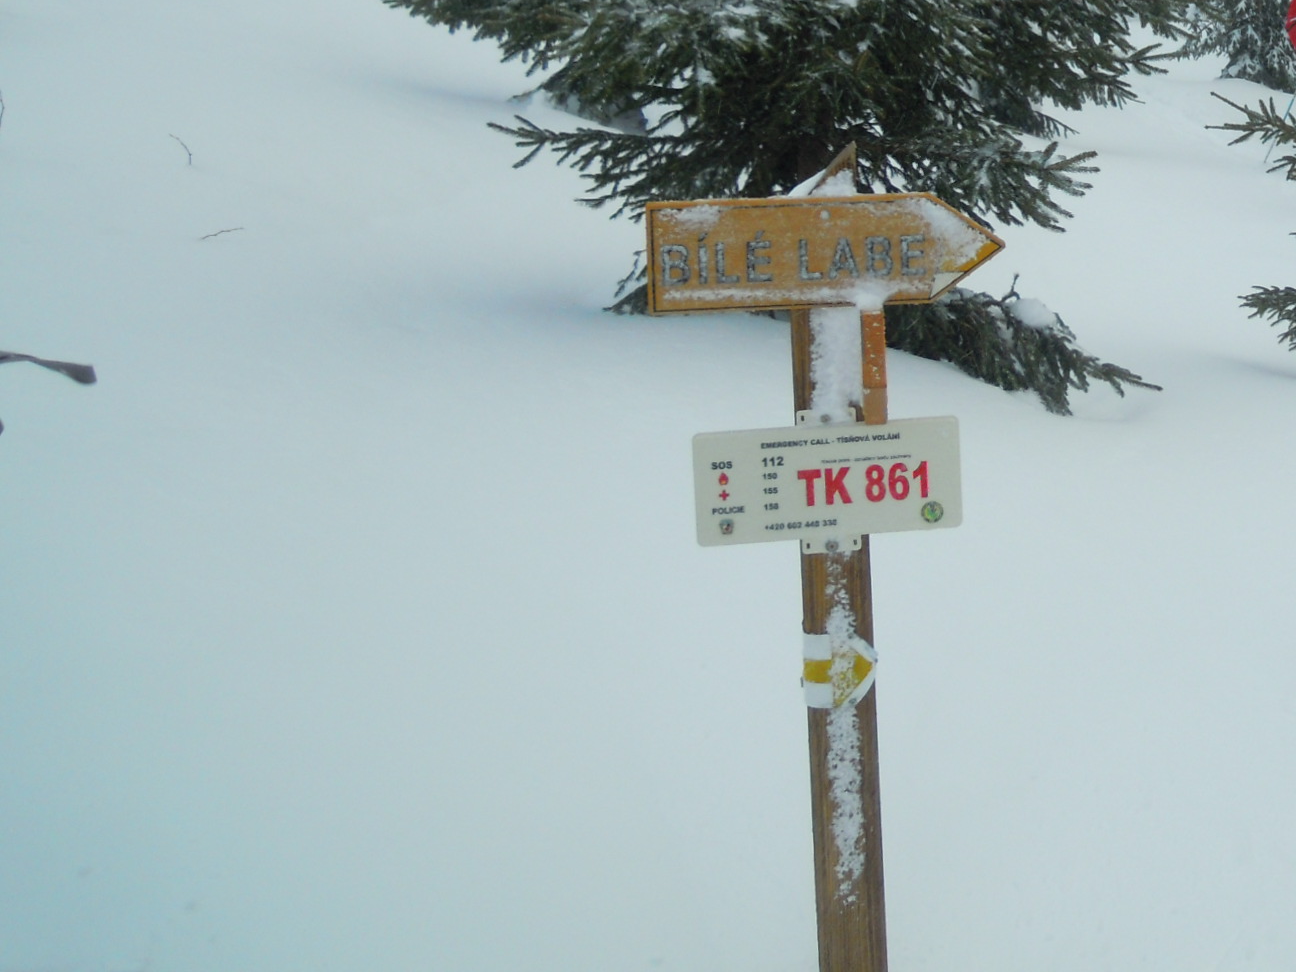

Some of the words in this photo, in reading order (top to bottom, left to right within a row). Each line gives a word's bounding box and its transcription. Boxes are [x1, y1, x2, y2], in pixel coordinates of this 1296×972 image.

[661, 230, 773, 286] BÍLÉ
[798, 234, 926, 281] LABE
[760, 440, 808, 449] EMERGENCY
[810, 438, 830, 446] CALL
[871, 432, 901, 442] VOLÁNÍ
[711, 460, 733, 470] SOS
[761, 456, 785, 467] 112
[762, 472, 778, 480] 150
[797, 466, 853, 507] TK
[865, 461, 929, 503] 861
[762, 487, 779, 495] 155
[711, 505, 745, 515] POLICIE
[764, 522, 785, 531] +420
